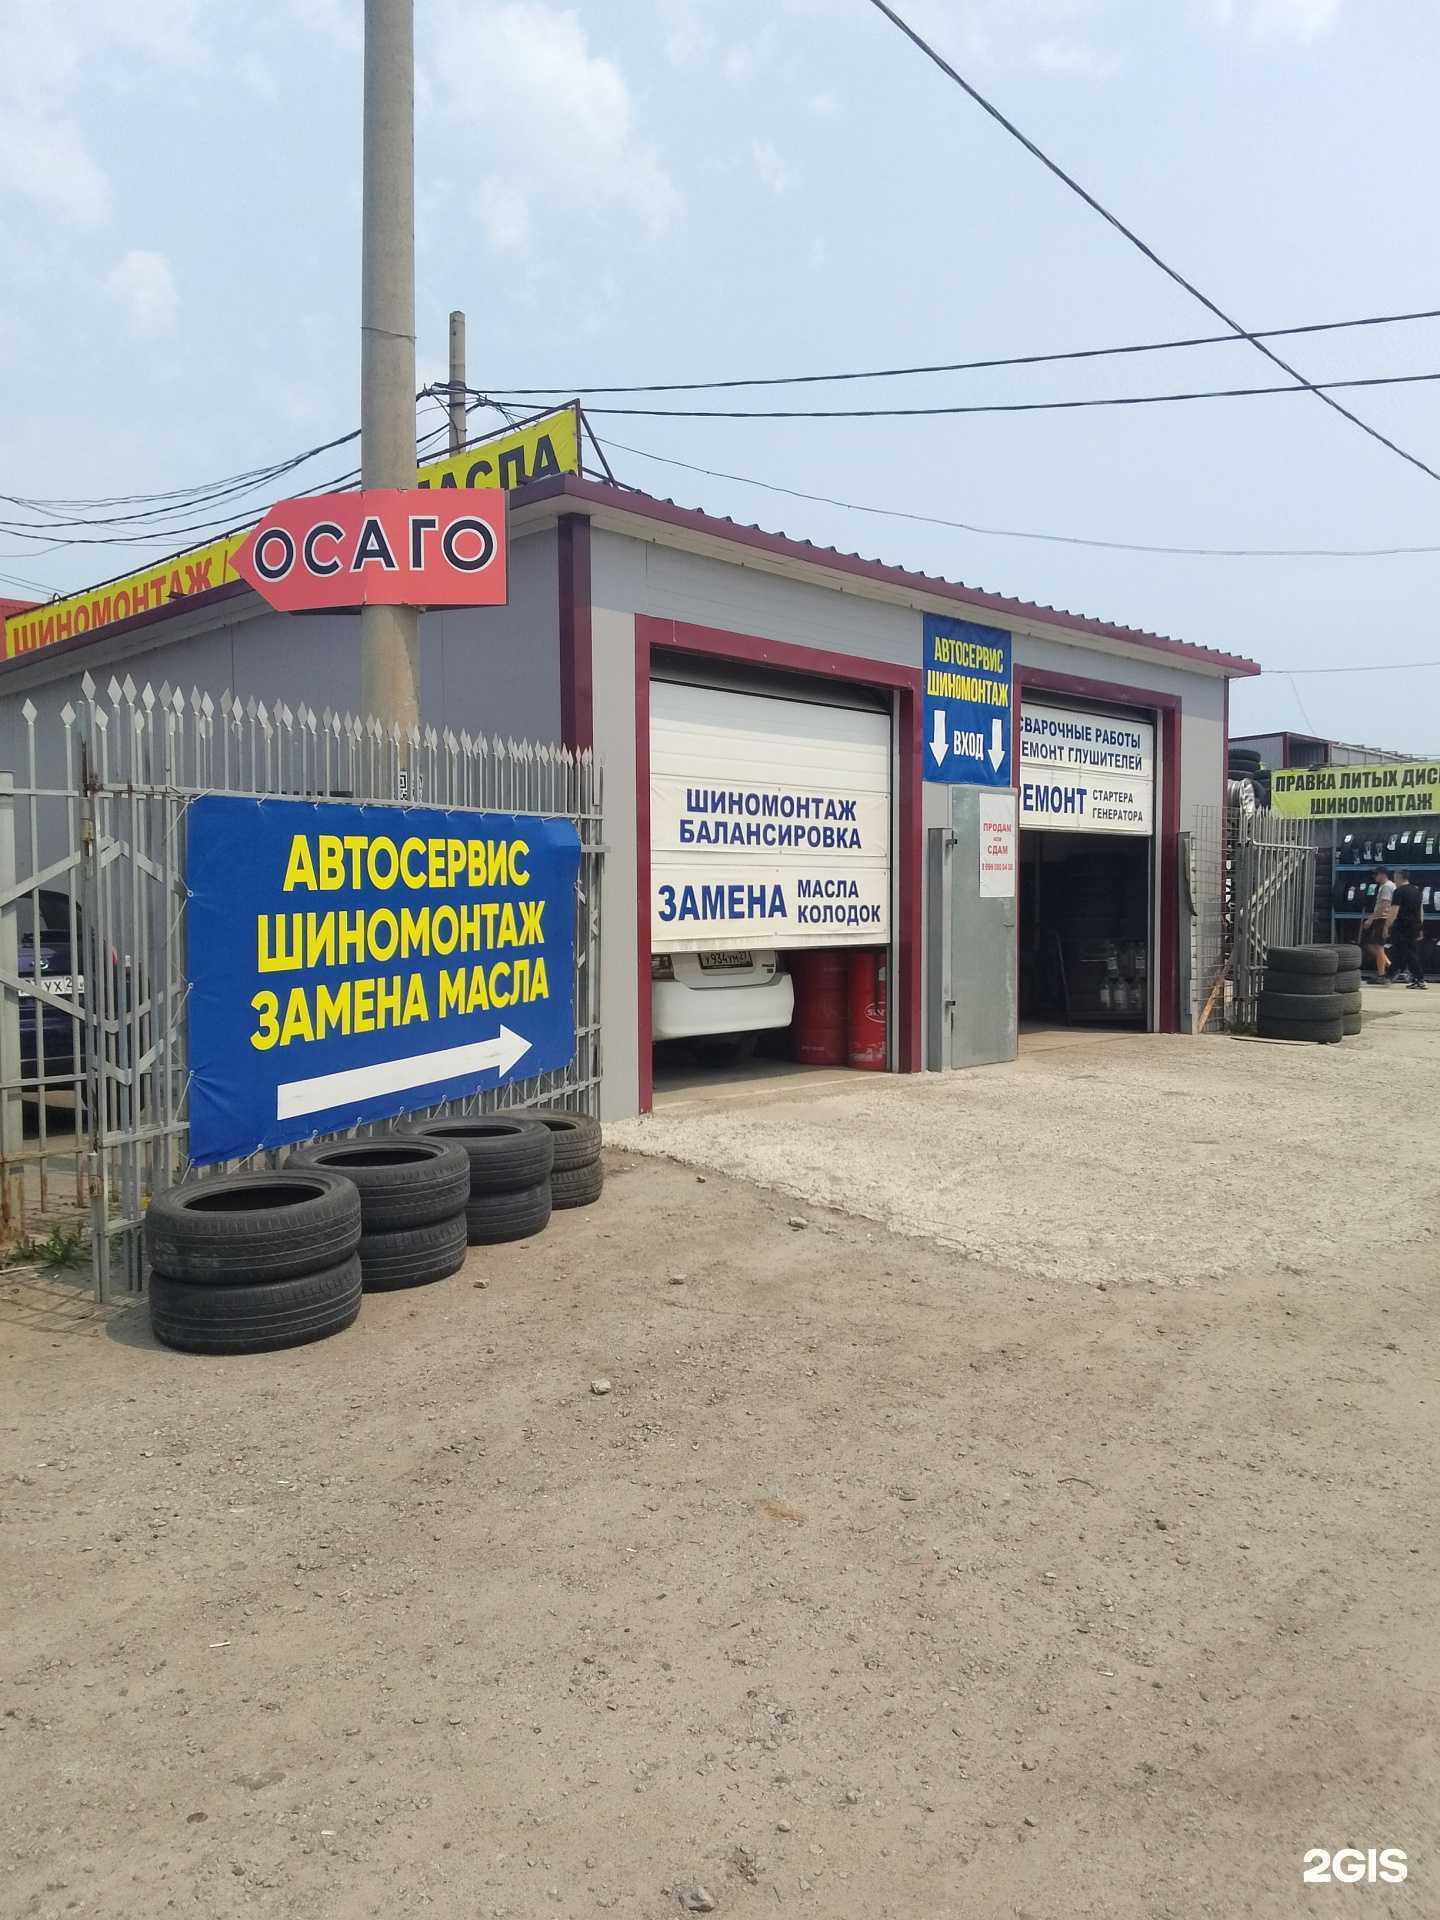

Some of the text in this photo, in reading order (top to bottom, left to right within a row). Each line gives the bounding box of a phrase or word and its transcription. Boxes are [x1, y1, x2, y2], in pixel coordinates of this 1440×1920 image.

[253, 516, 497, 582] ОСАГО
[13, 557, 212, 651] ШИНОМОНТАЖ
[934, 637, 1004, 673] АВТОСЕРВИС
[927, 670, 1008, 707] ШИНОМОНТАЖ
[953, 730, 984, 760] ВХОД
[1095, 728, 1141, 749] РАБОТЫ
[1068, 747, 1142, 771] ГЛУШИТЕЛЕЙ
[1275, 767, 1440, 792] ПРАВКА ЛИТЫХ ДИС
[687, 788, 856, 821] ШИНОМОНТАЖ
[1020, 783, 1087, 815] ЕМОНТ
[1092, 789, 1133, 804] СТАРТЕРА
[1310, 793, 1432, 815] ШИНОМОНТАЖ
[983, 823, 1012, 833] ПРОДАМ
[1092, 807, 1143, 822] ГЕНЕРАТОРА
[679, 819, 862, 849] БАЛАНСИРОВКА
[283, 834, 530, 891] АВТОСЕРВИС
[987, 845, 1009, 856] СДАМ
[658, 884, 787, 921] ЗАМЕНА
[798, 879, 859, 898] МАСЛА
[798, 905, 881, 926] КОЛОДОК
[257, 901, 545, 973] ШИНОМОНТАЖ
[250, 956, 549, 1050] ЗАМЕНА МАСЛА
